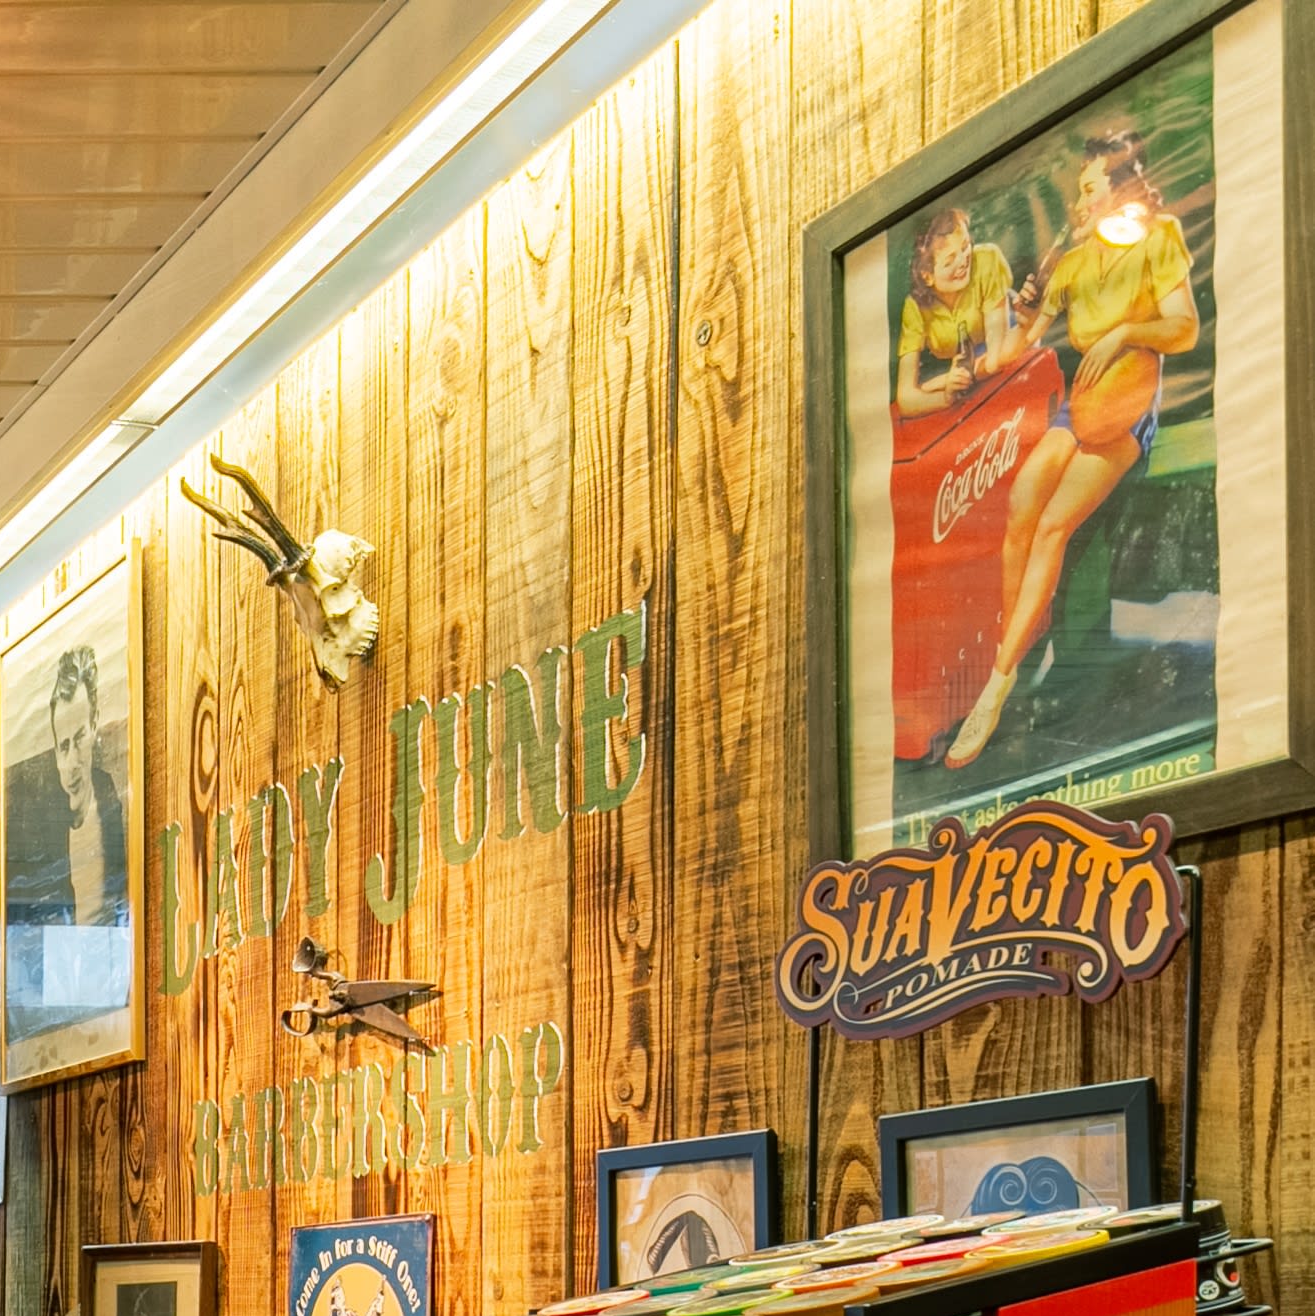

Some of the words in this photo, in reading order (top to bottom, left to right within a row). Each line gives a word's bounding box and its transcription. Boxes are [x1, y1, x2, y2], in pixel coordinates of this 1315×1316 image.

[156, 755, 346, 997] LADY
[364, 600, 647, 926] JUNE
[1129, 752, 1202, 791] more
[779, 818, 1170, 1011] SUAVECITO
[883, 942, 1034, 1012] POMADE
[193, 1020, 565, 1198] BARBERSHOP
[319, 1251, 333, 1272] In
[334, 1238, 354, 1261] for
[356, 1238, 365, 1254] a
[368, 1235, 399, 1270] Stiff
